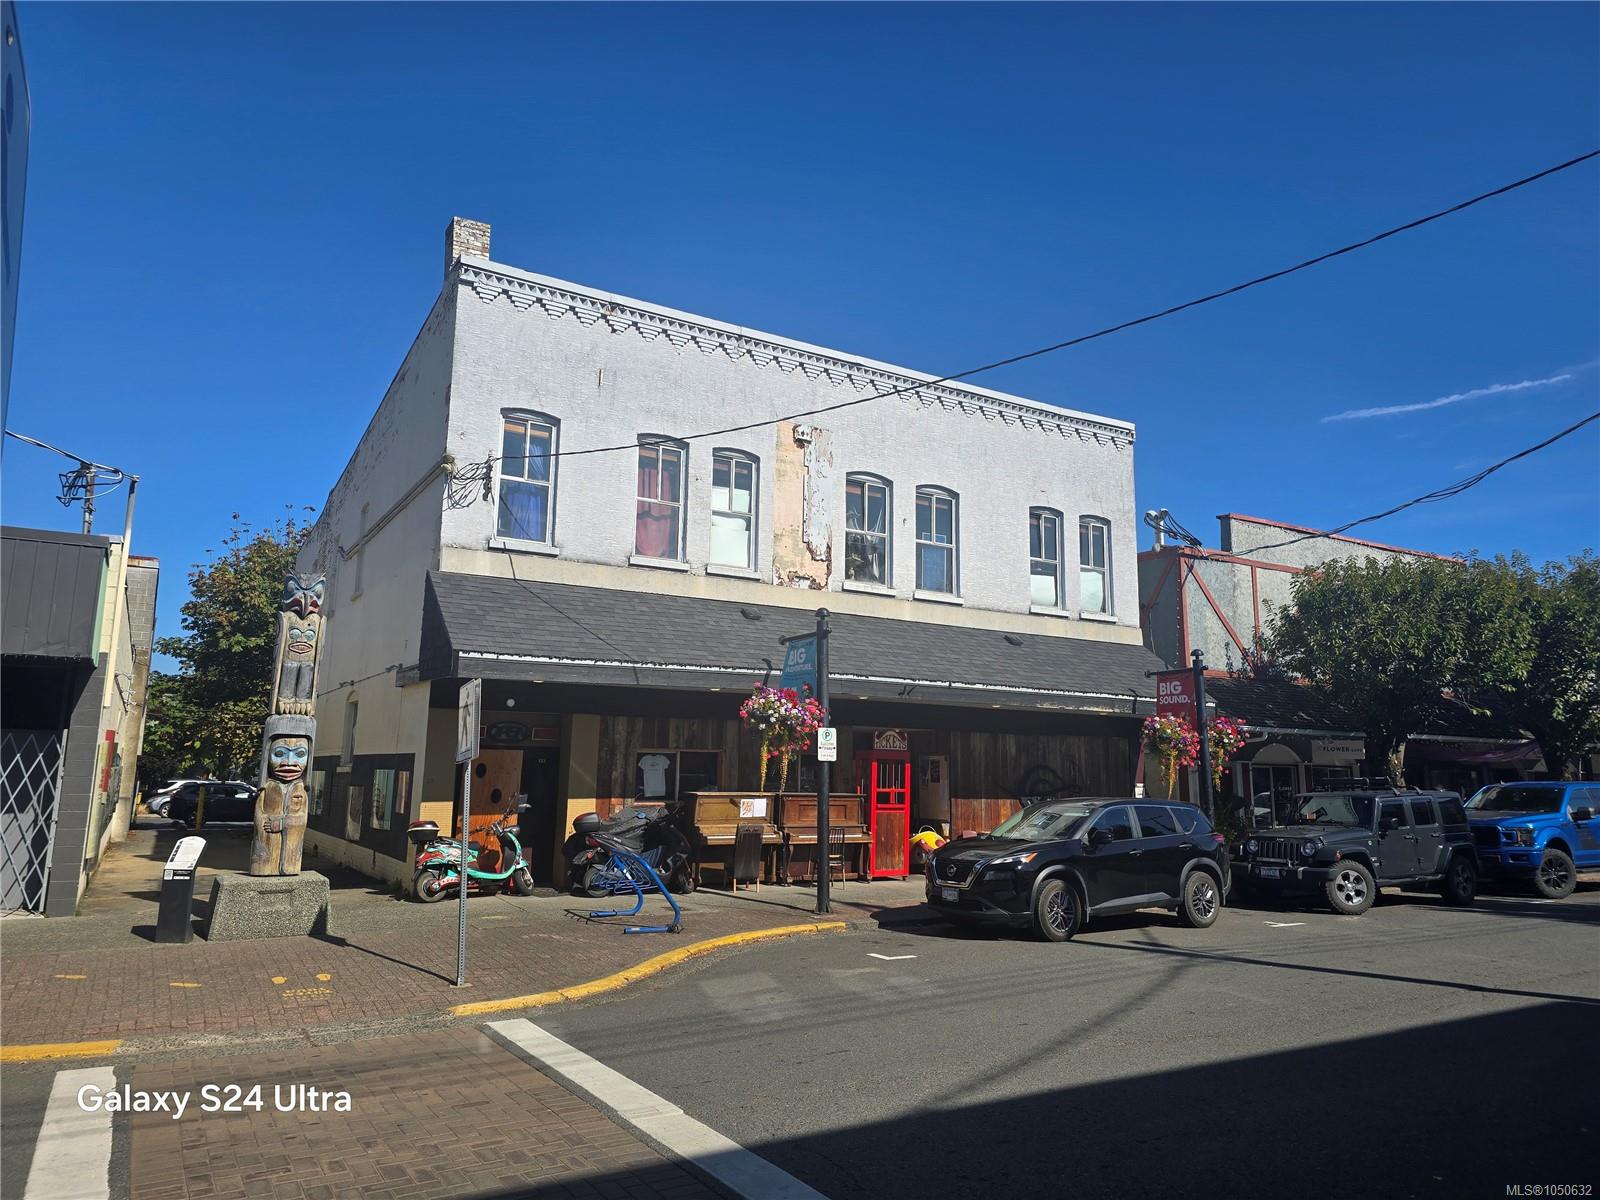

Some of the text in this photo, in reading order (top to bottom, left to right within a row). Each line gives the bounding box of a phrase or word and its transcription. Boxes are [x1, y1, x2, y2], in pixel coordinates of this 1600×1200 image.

[788, 648, 806, 665] BIG
[1160, 681, 1182, 695] BIG
[1160, 695, 1190, 704] SOUND.
